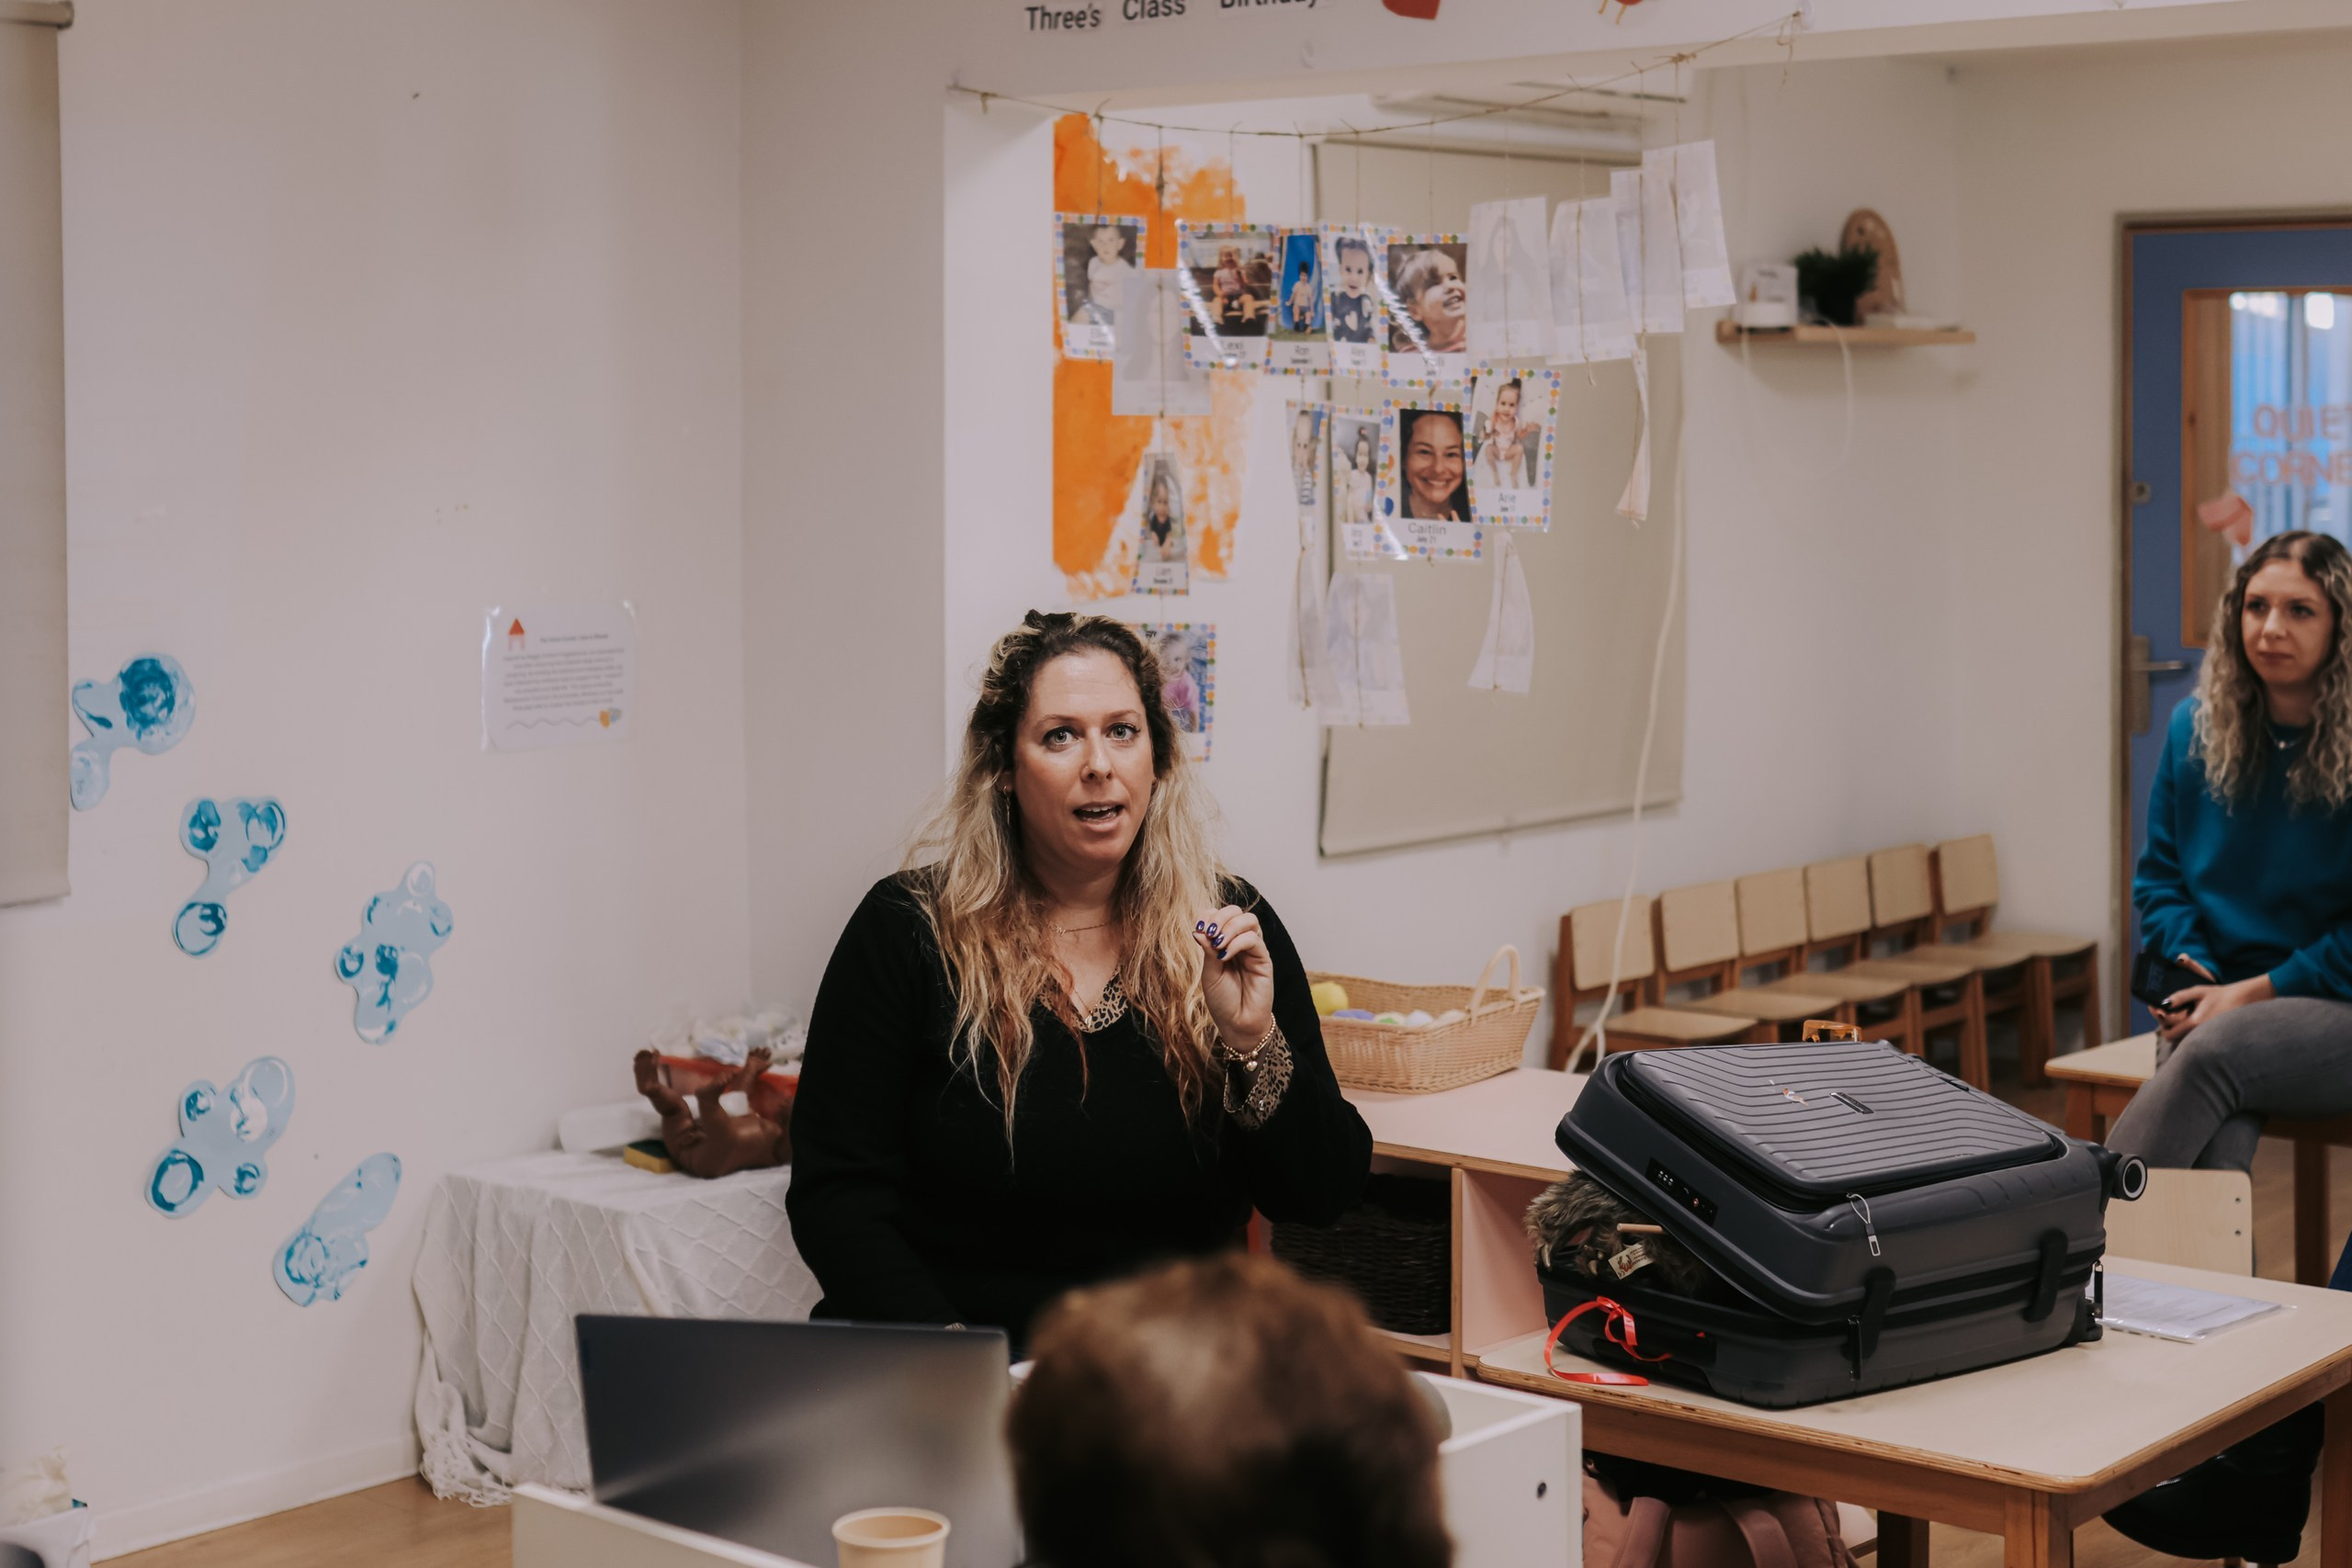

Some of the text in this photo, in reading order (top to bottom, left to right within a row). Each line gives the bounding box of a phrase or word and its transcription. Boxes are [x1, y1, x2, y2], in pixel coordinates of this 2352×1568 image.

[1024, 0, 1186, 30] Three's Class
[1408, 522, 1446, 535] Caitlin
